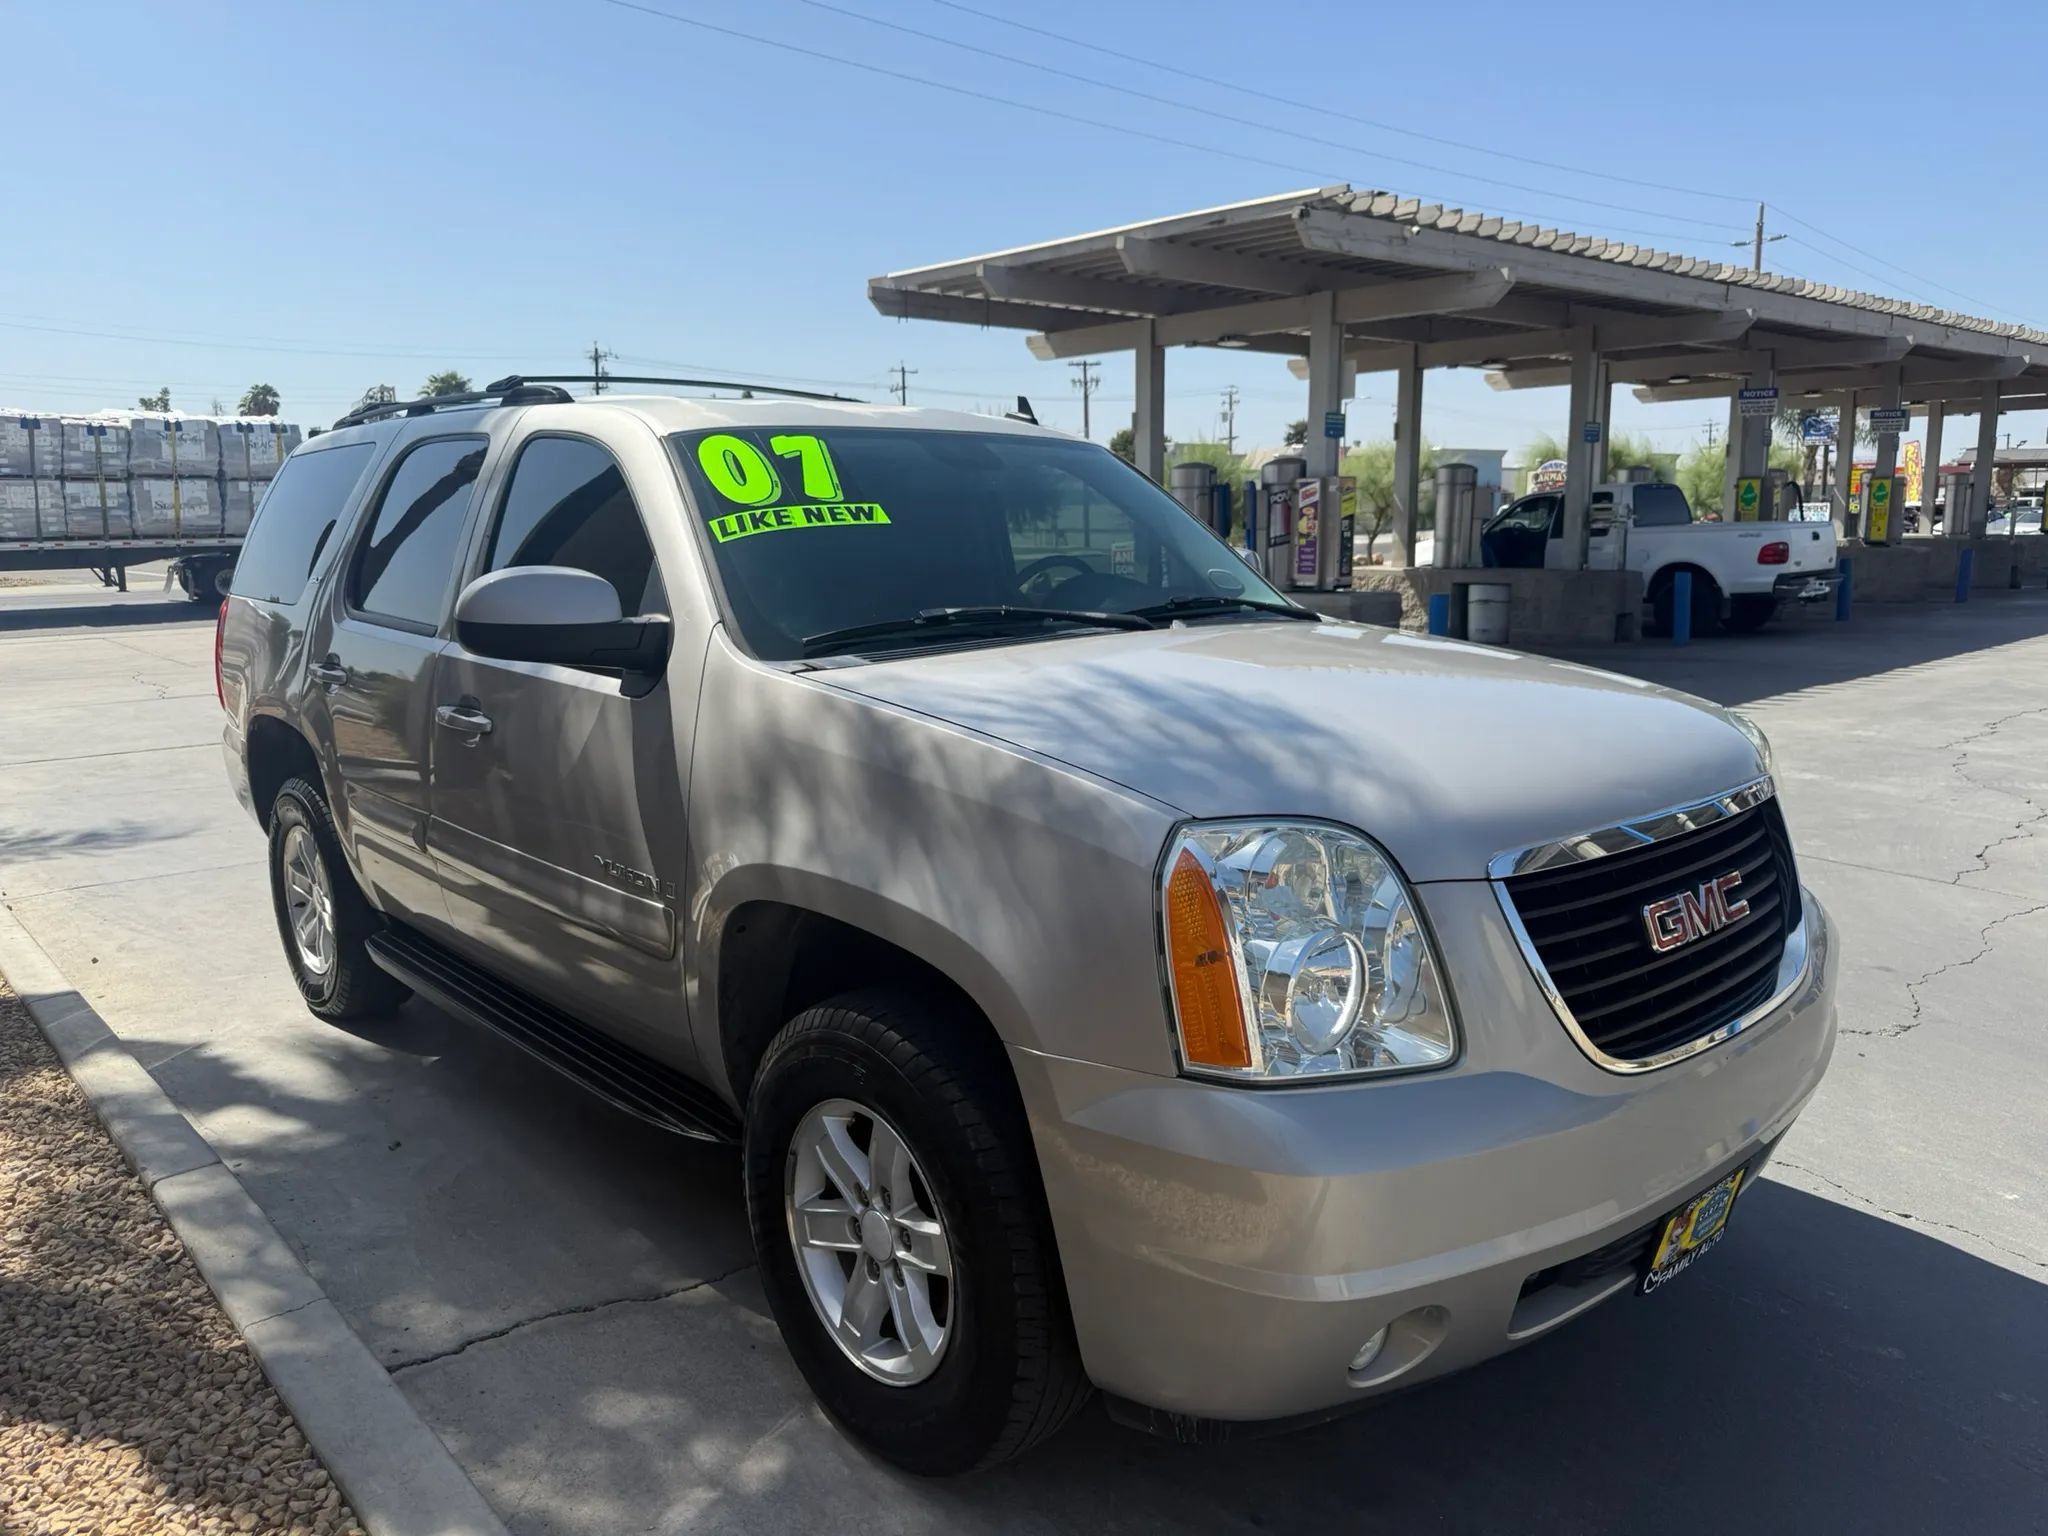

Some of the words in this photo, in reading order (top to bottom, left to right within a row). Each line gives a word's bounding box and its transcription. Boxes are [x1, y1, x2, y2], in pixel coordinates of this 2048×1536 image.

[1743, 389, 1775, 398] NOTICE
[698, 435, 844, 506] 07
[717, 508, 792, 538] LIKE
[801, 505, 876, 524] NEW
[1643, 870, 1750, 951] GMC
[1656, 1247, 1699, 1288] FAMILY
[1696, 1226, 1725, 1260] AUTO
